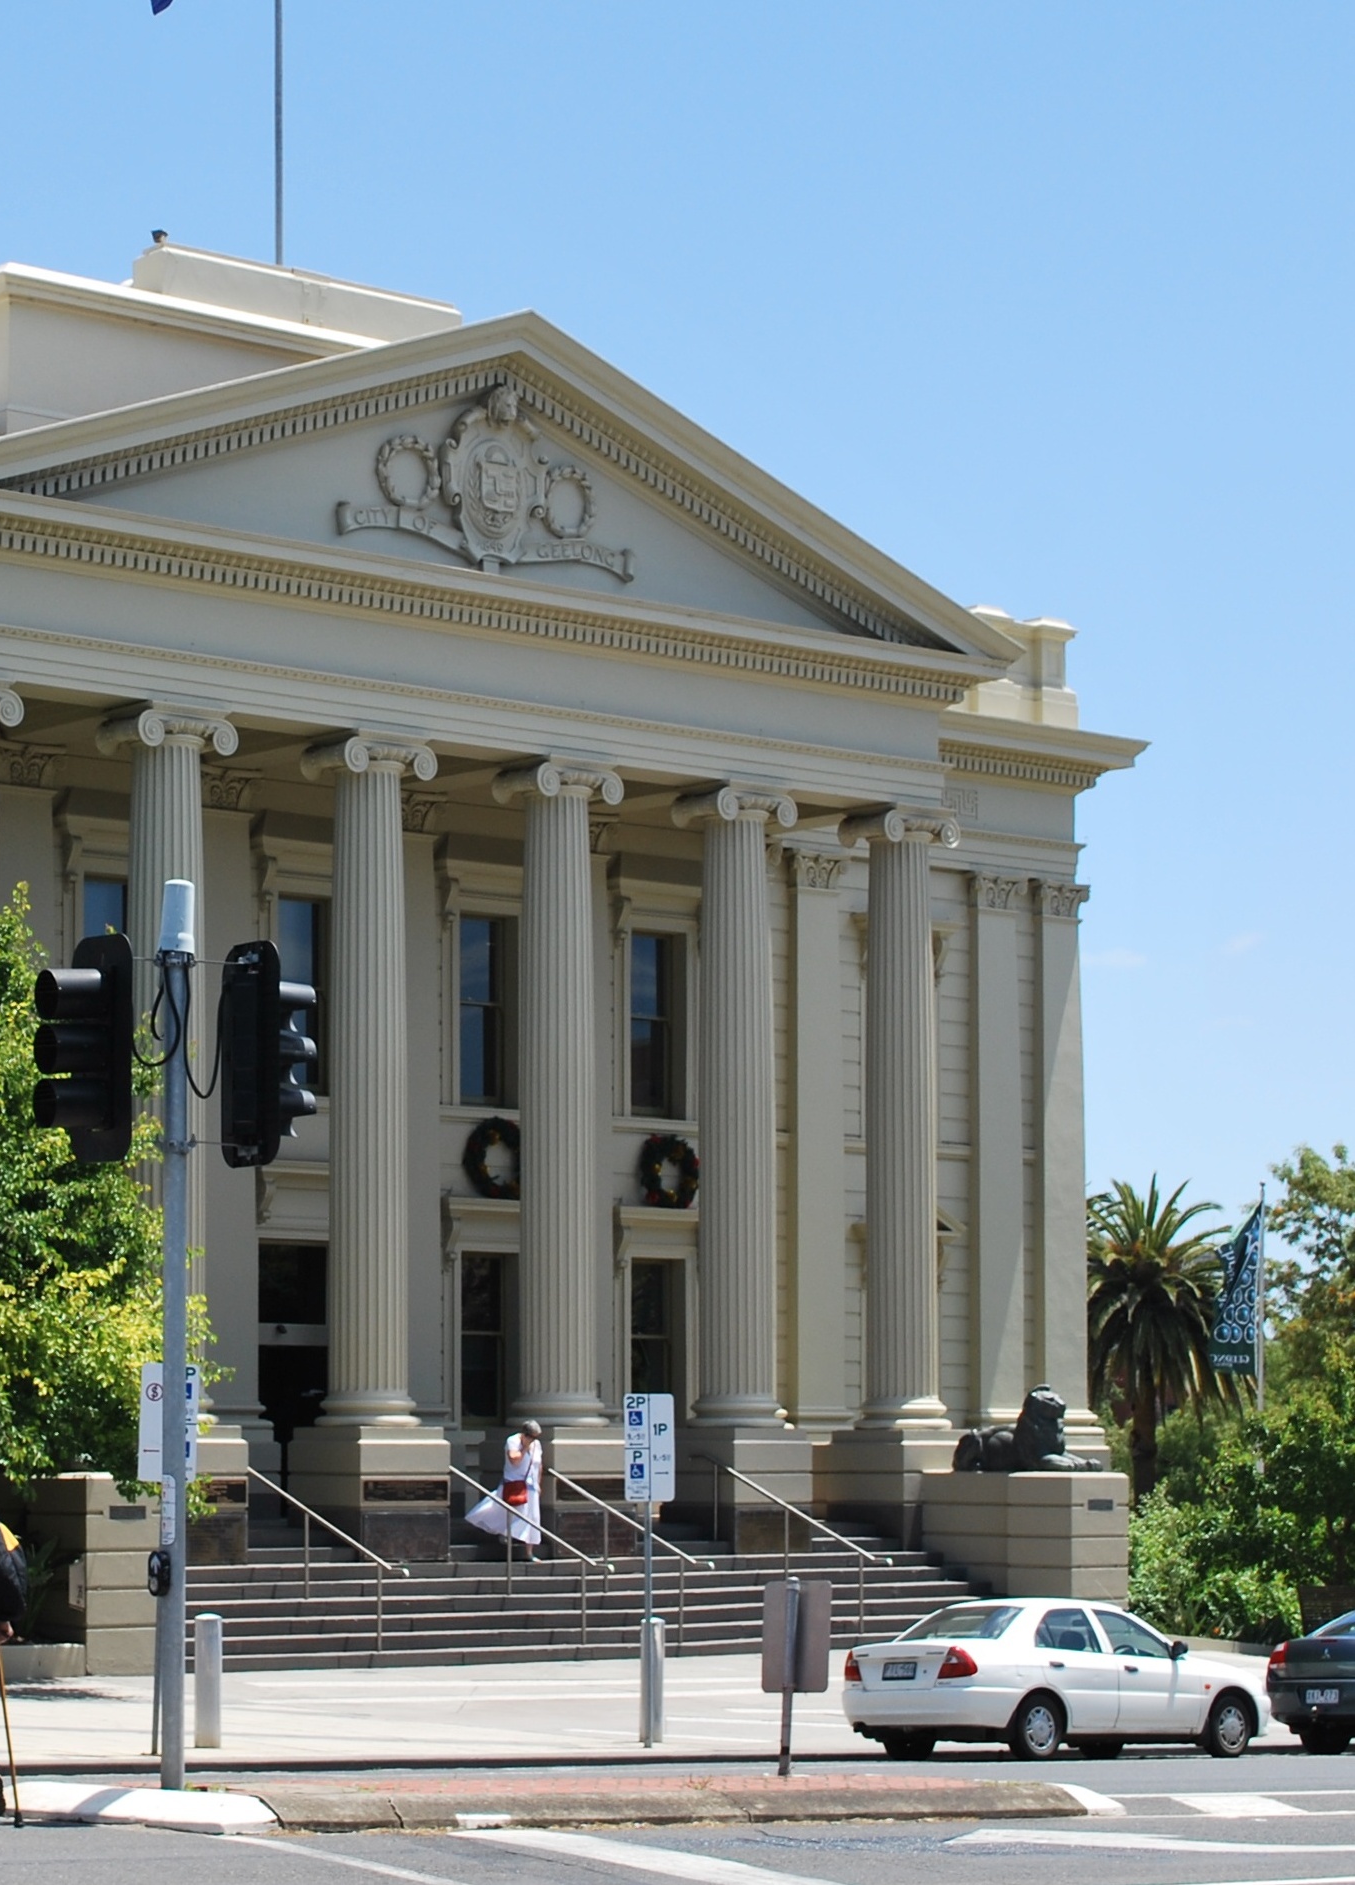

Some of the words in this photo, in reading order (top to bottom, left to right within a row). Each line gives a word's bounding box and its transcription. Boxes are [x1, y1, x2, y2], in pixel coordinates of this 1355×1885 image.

[354, 508, 388, 526] CITY
[413, 515, 438, 535] OF
[537, 541, 615, 567] GEELONG
[626, 1396, 646, 1409] 2P
[653, 1423, 668, 1436] 1P
[633, 1450, 643, 1463] P
